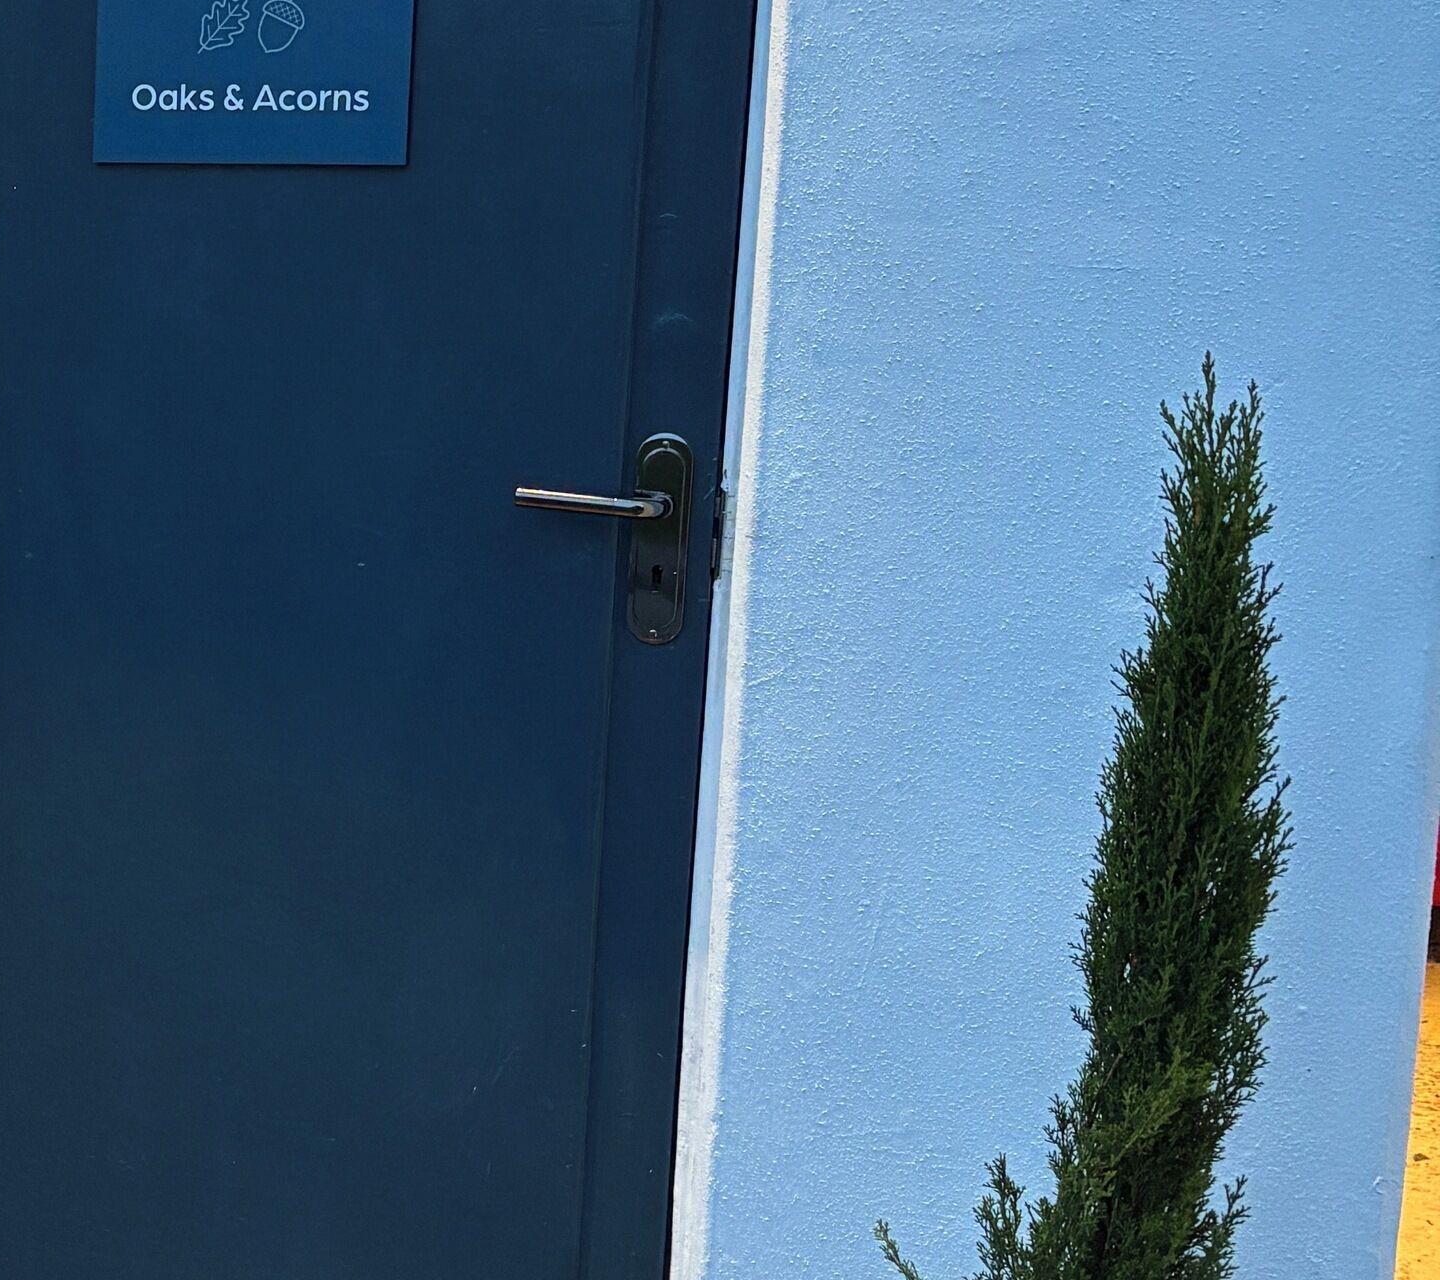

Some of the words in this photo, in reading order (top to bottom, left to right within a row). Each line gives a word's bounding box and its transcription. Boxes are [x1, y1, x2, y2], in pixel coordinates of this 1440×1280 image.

[131, 83, 215, 111] Oaks
[223, 84, 244, 111] &
[252, 84, 369, 111] Acorns
